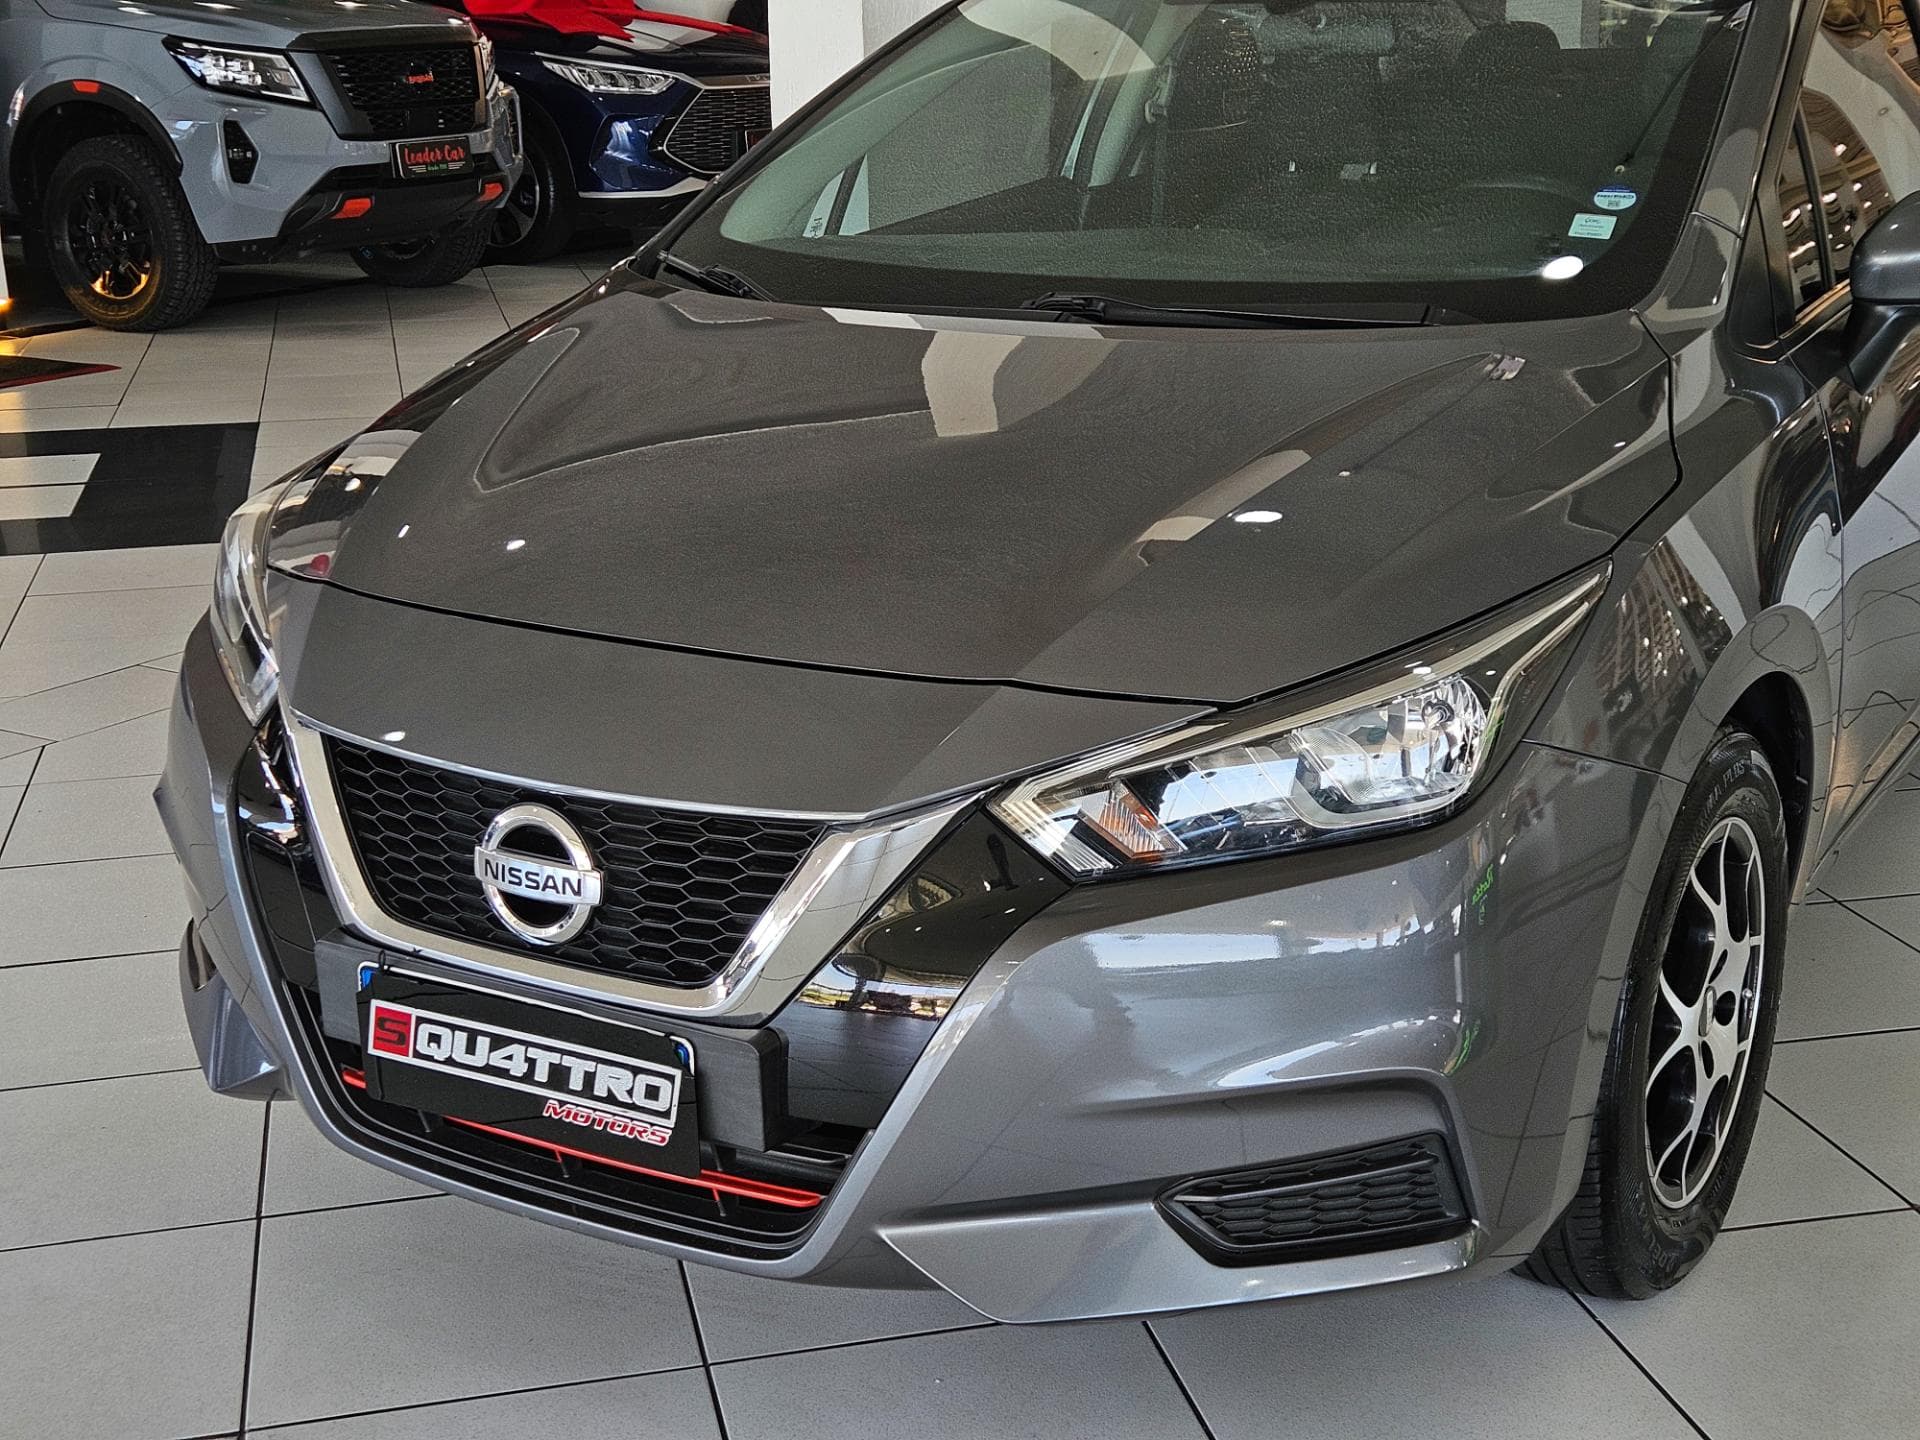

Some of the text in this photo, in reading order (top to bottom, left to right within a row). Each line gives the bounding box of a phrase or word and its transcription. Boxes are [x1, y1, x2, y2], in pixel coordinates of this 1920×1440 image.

[404, 144, 465, 164] Leader Car
[484, 858, 582, 897] NISSAN
[542, 1099, 672, 1147] MOTORS
